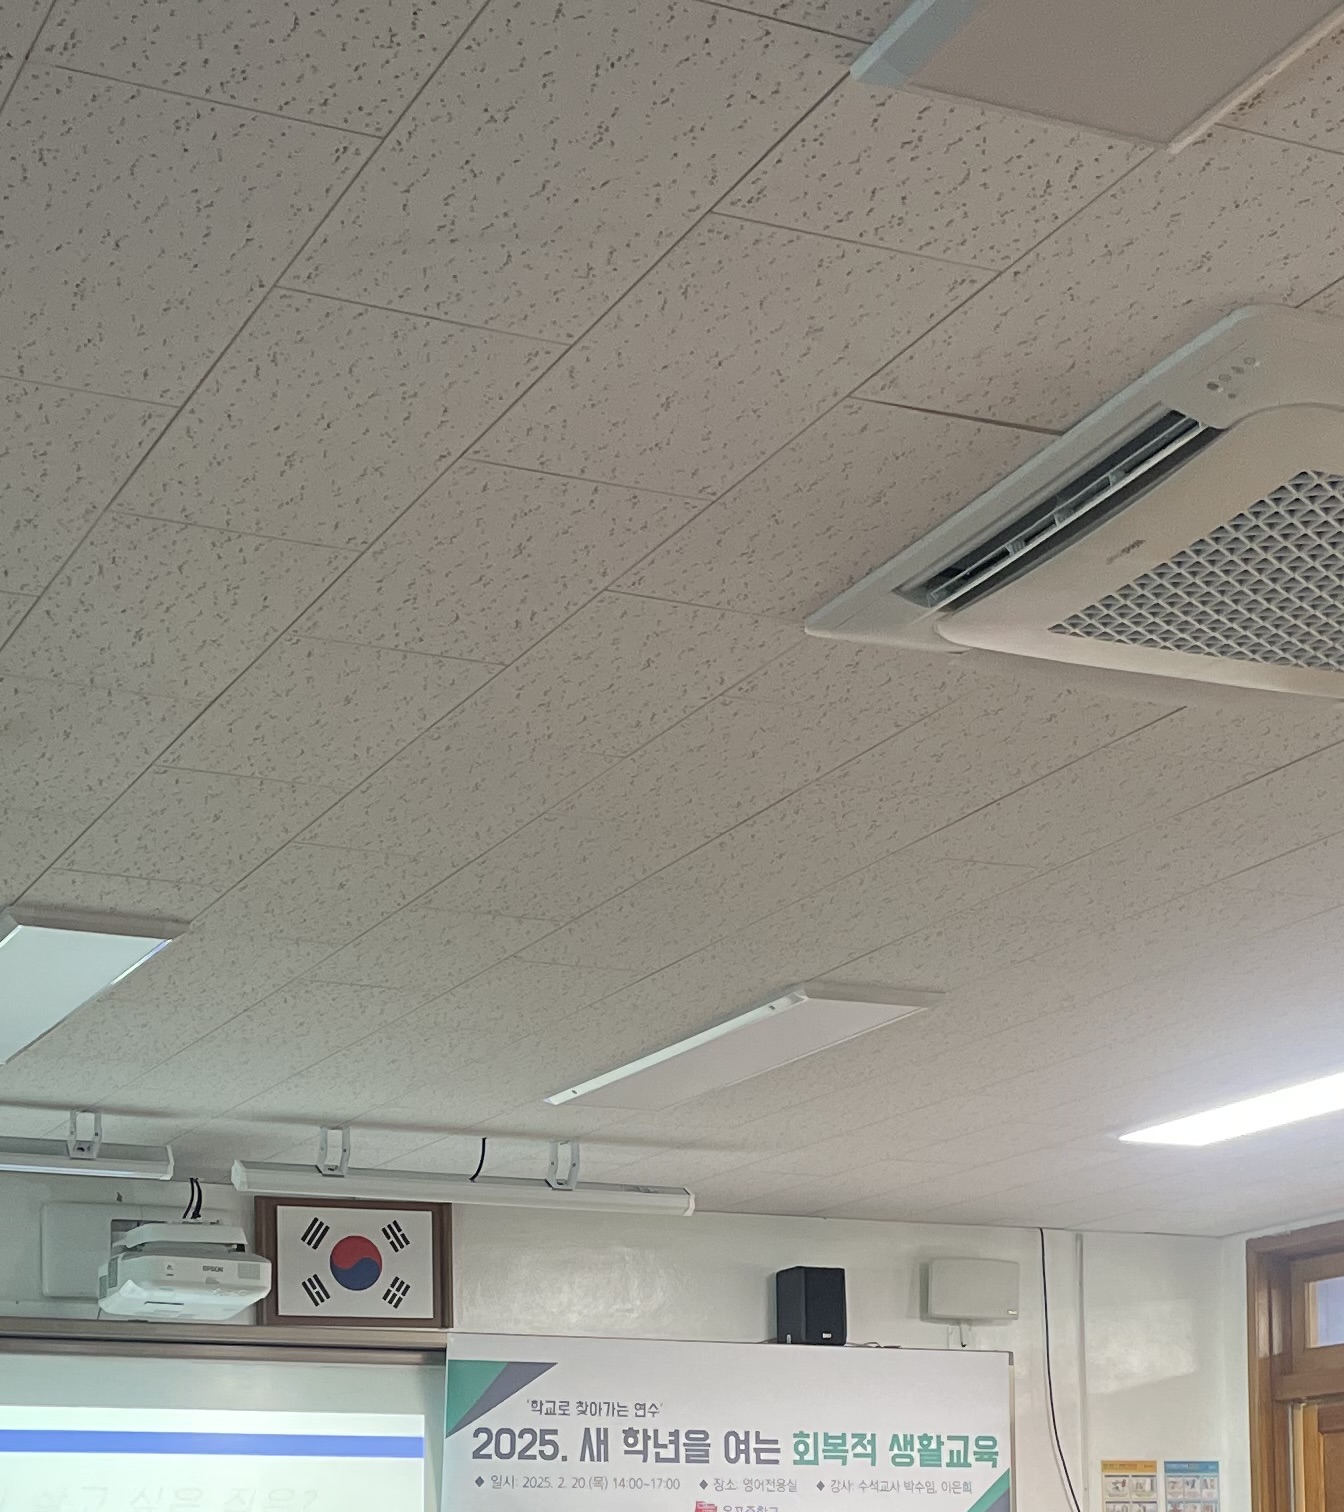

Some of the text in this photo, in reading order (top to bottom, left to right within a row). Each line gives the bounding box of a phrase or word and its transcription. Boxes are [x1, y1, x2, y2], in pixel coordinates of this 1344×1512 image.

[575, 1400, 629, 1418] 찾아가는
[472, 1427, 999, 1469] 2025. 새 학년을 여는 회복적 생활교육
[613, 1477, 680, 1490] 14:00~17:00
[742, 1477, 798, 1493] 영어전용실
[858, 1479, 900, 1494] 수석교사
